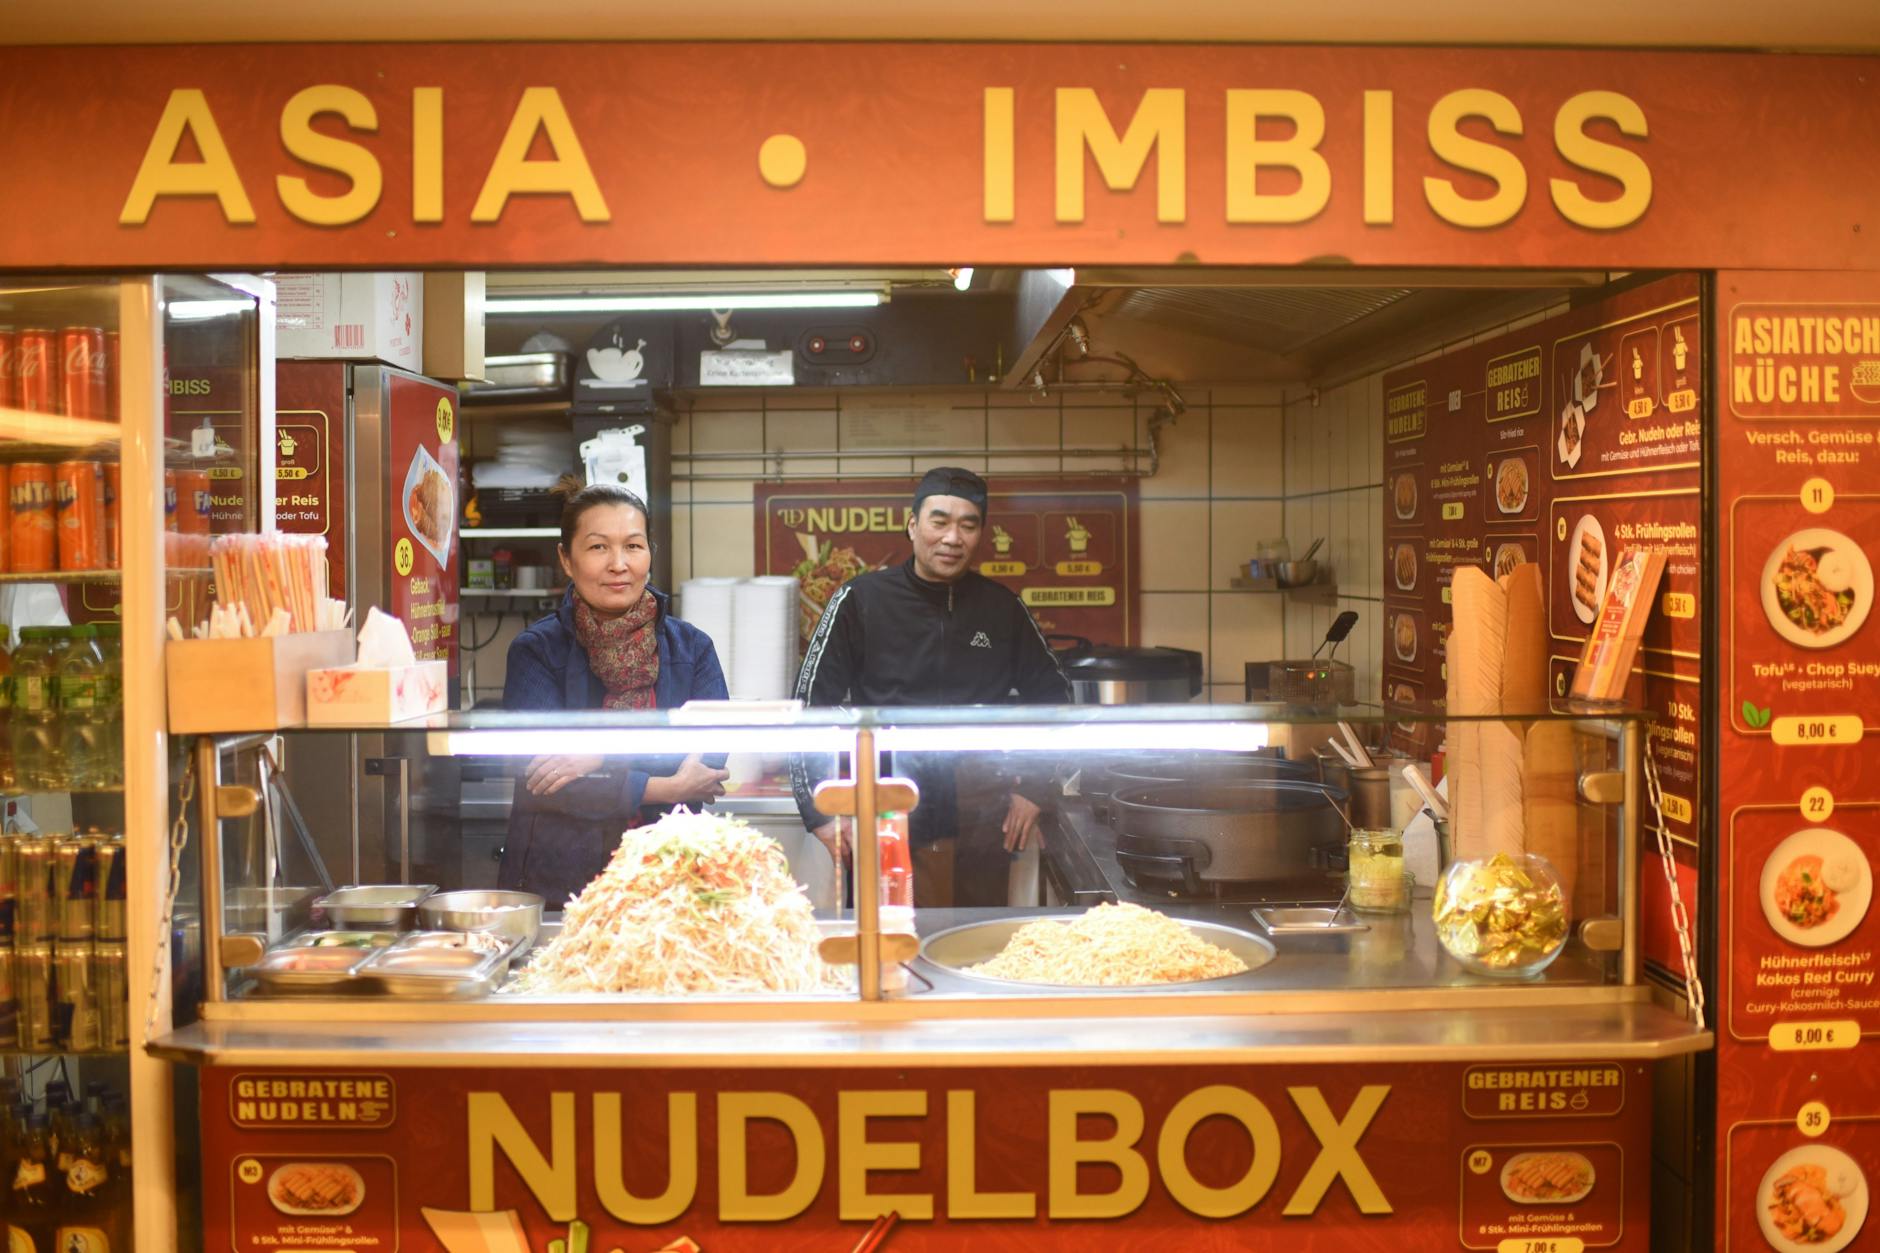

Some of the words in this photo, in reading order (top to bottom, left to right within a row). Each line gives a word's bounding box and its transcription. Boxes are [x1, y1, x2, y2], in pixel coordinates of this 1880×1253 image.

[118, 84, 612, 226] ASIA
[983, 87, 1654, 229] IMBISS
[1734, 358, 1841, 403] KÜCHE
[1497, 387, 1521, 412] REIS
[1638, 426, 1665, 443] Nudeln
[1665, 423, 1684, 439] oder
[1746, 430, 1804, 445] Versch.
[1808, 430, 1873, 444] Gemüse
[1776, 450, 1813, 464] Reis,
[1816, 450, 1860, 464] dazu:
[277, 469, 293, 479] 5,50
[294, 469, 300, 478] €
[209, 495, 244, 507] Nude
[291, 495, 319, 506] Reis
[1812, 488, 1823, 503] 11
[276, 511, 297, 521] oder
[299, 511, 320, 521] Tofu
[1620, 526, 1635, 539] Stk.
[1635, 521, 1697, 543] Frühlingsrollen
[1031, 590, 1085, 601] GEBRATENER
[1087, 590, 1106, 601] REIS
[1806, 663, 1844, 677] Chop
[1848, 662, 1880, 677] Suey
[1782, 678, 1854, 692] (vegetarisch)
[1678, 703, 1696, 722] Stk.
[1797, 723, 1825, 740] 8,00
[1829, 724, 1837, 738] €
[1809, 797, 1825, 812] 22
[1756, 973, 1800, 987] Kokos
[1803, 972, 1832, 984] Red
[1835, 970, 1875, 985] Curry
[1794, 1029, 1822, 1045] 8,00
[1826, 1030, 1834, 1043] €
[1468, 1069, 1619, 1089] GEBRATENER
[237, 1081, 389, 1099] GEBRATENE
[1498, 1091, 1567, 1111] REIS
[237, 1102, 357, 1121] NUDELN
[1805, 1111, 1821, 1127] 35
[467, 1084, 1395, 1225] NUDELBOX
[1508, 1214, 1525, 1223] mit
[1527, 1213, 1565, 1223] Gemüse
[1487, 1225, 1506, 1235] Stk.
[1508, 1223, 1603, 1236] Mini-Frühlingsrollen
[261, 1236, 280, 1245] Stk.
[281, 1235, 379, 1248] Mini-Frühlingsrollen
